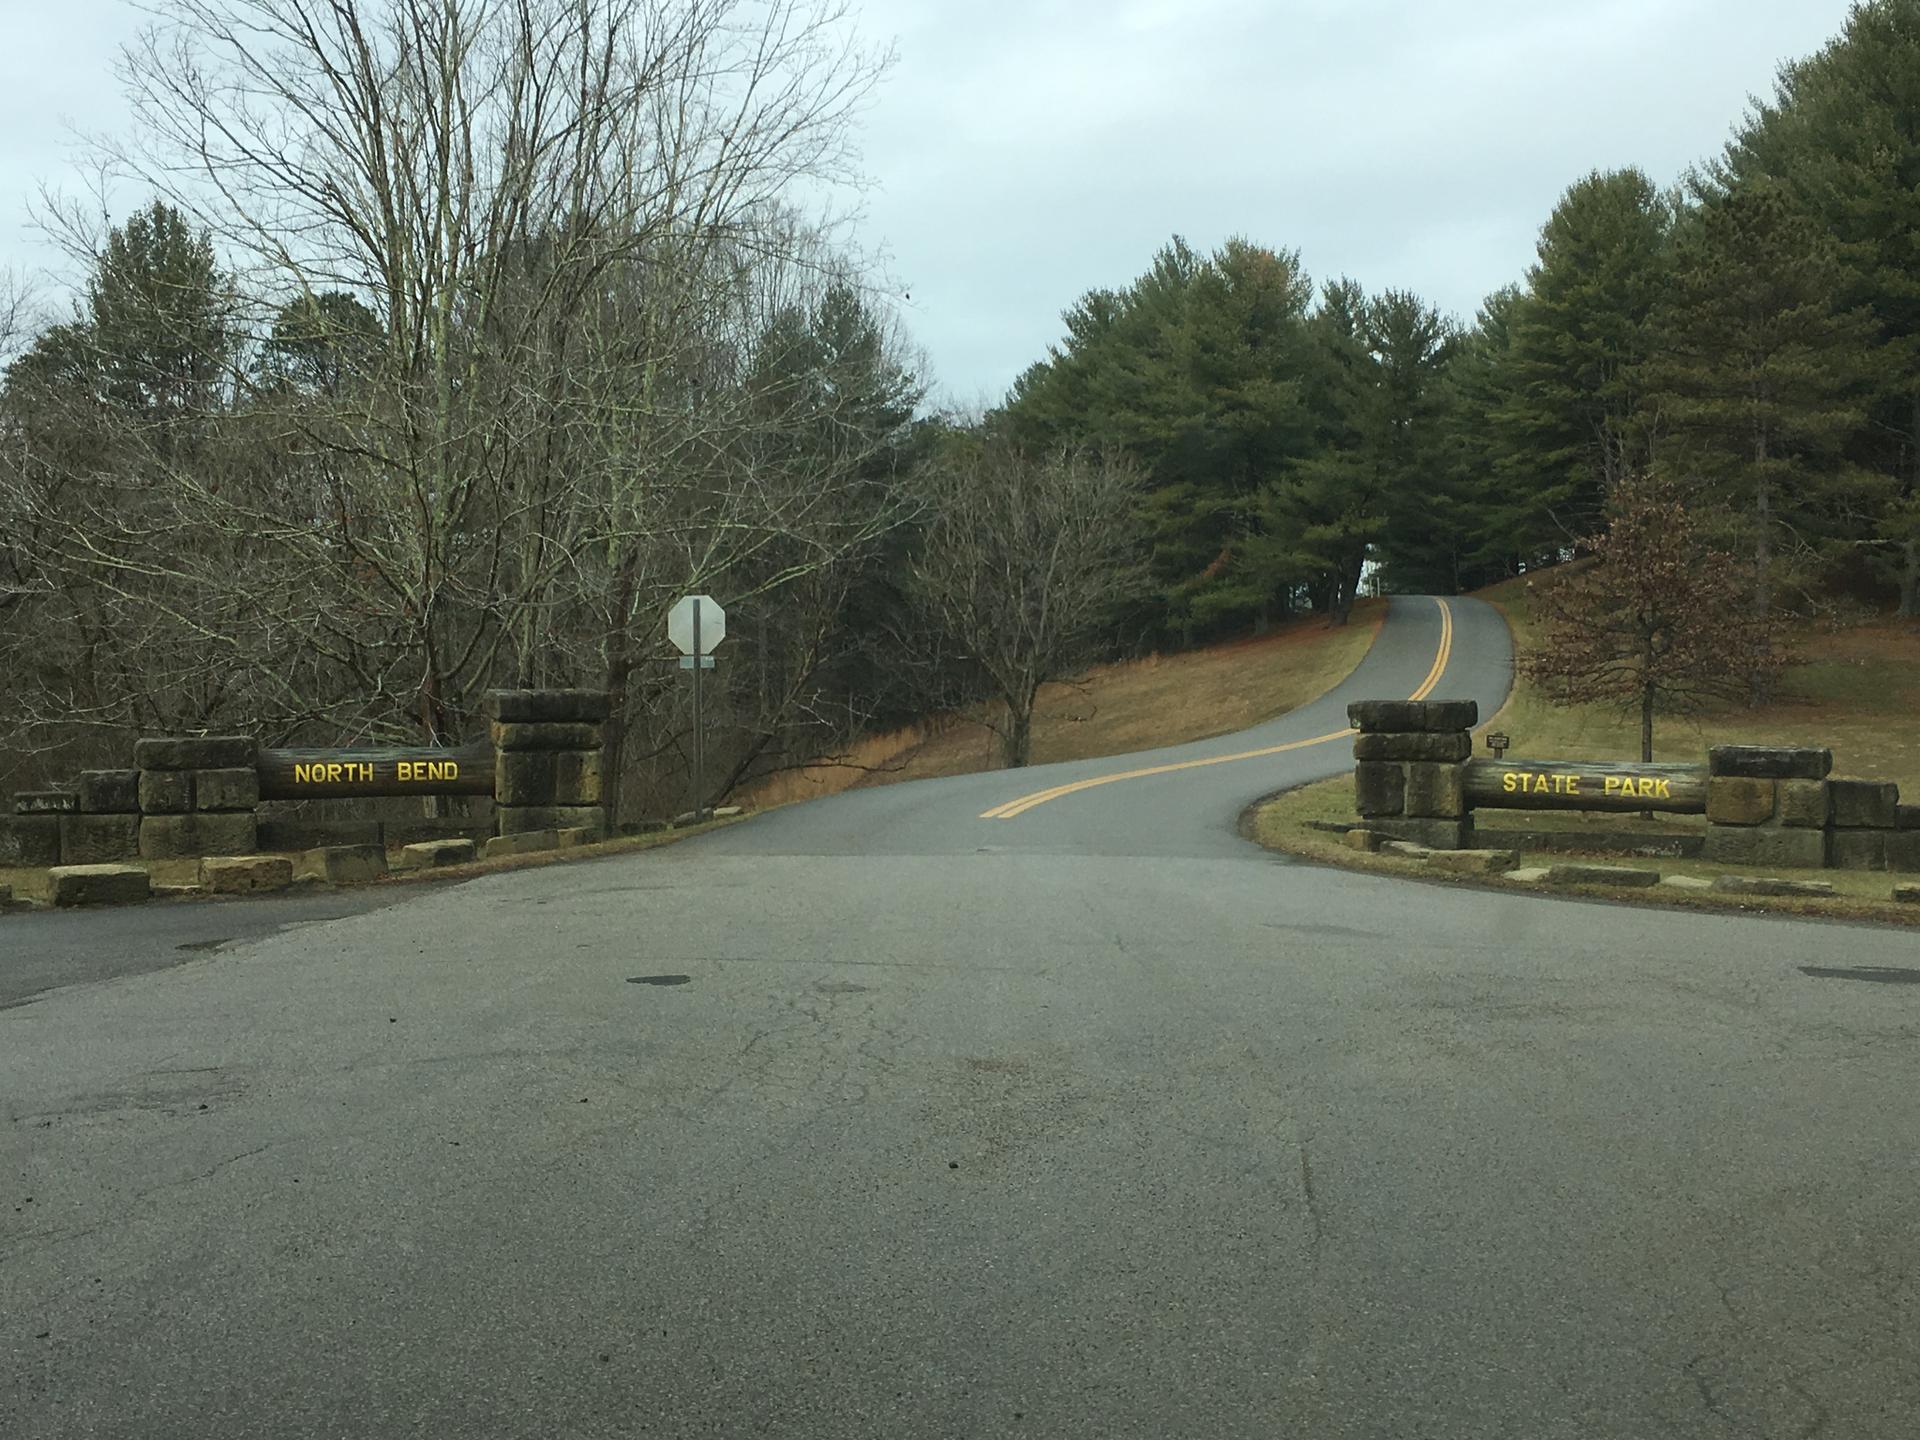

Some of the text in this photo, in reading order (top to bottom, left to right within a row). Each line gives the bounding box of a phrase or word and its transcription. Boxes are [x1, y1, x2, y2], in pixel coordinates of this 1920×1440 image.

[294, 761, 459, 784] NORTH BEND
[1502, 772, 1671, 799] STATE PARK
